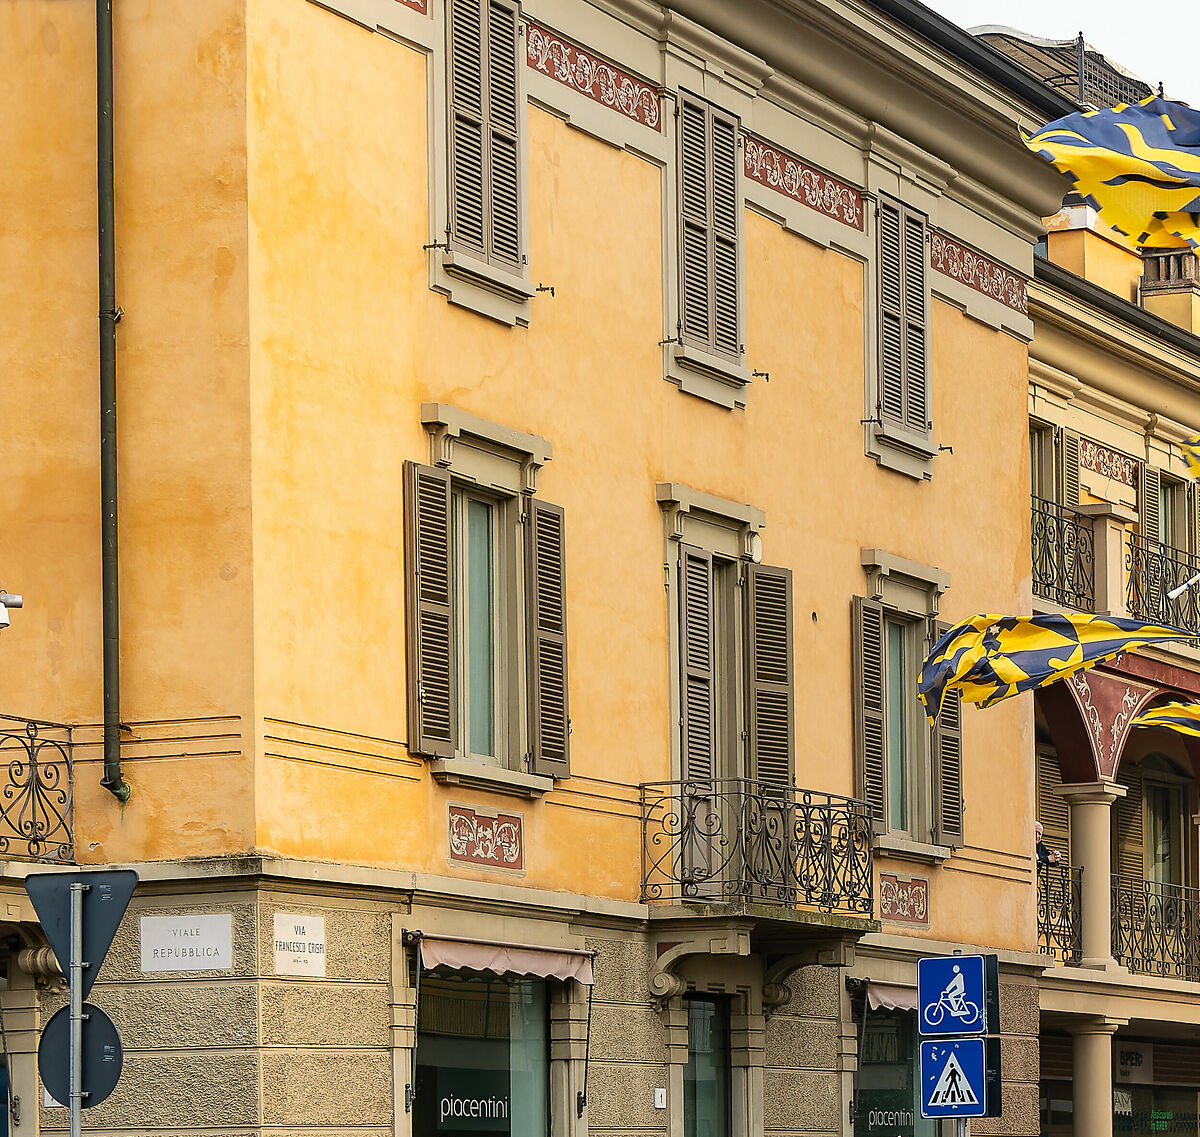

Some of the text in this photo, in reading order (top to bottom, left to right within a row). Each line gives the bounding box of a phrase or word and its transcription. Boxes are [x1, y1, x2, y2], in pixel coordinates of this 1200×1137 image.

[172, 928, 201, 937] VIALE
[293, 924, 306, 936] VIA
[153, 947, 220, 959] REPUBBLICA
[275, 940, 325, 954] FRANCESCO CRISPI
[440, 1093, 508, 1123] piacentini
[868, 1107, 914, 1131] piacentini
